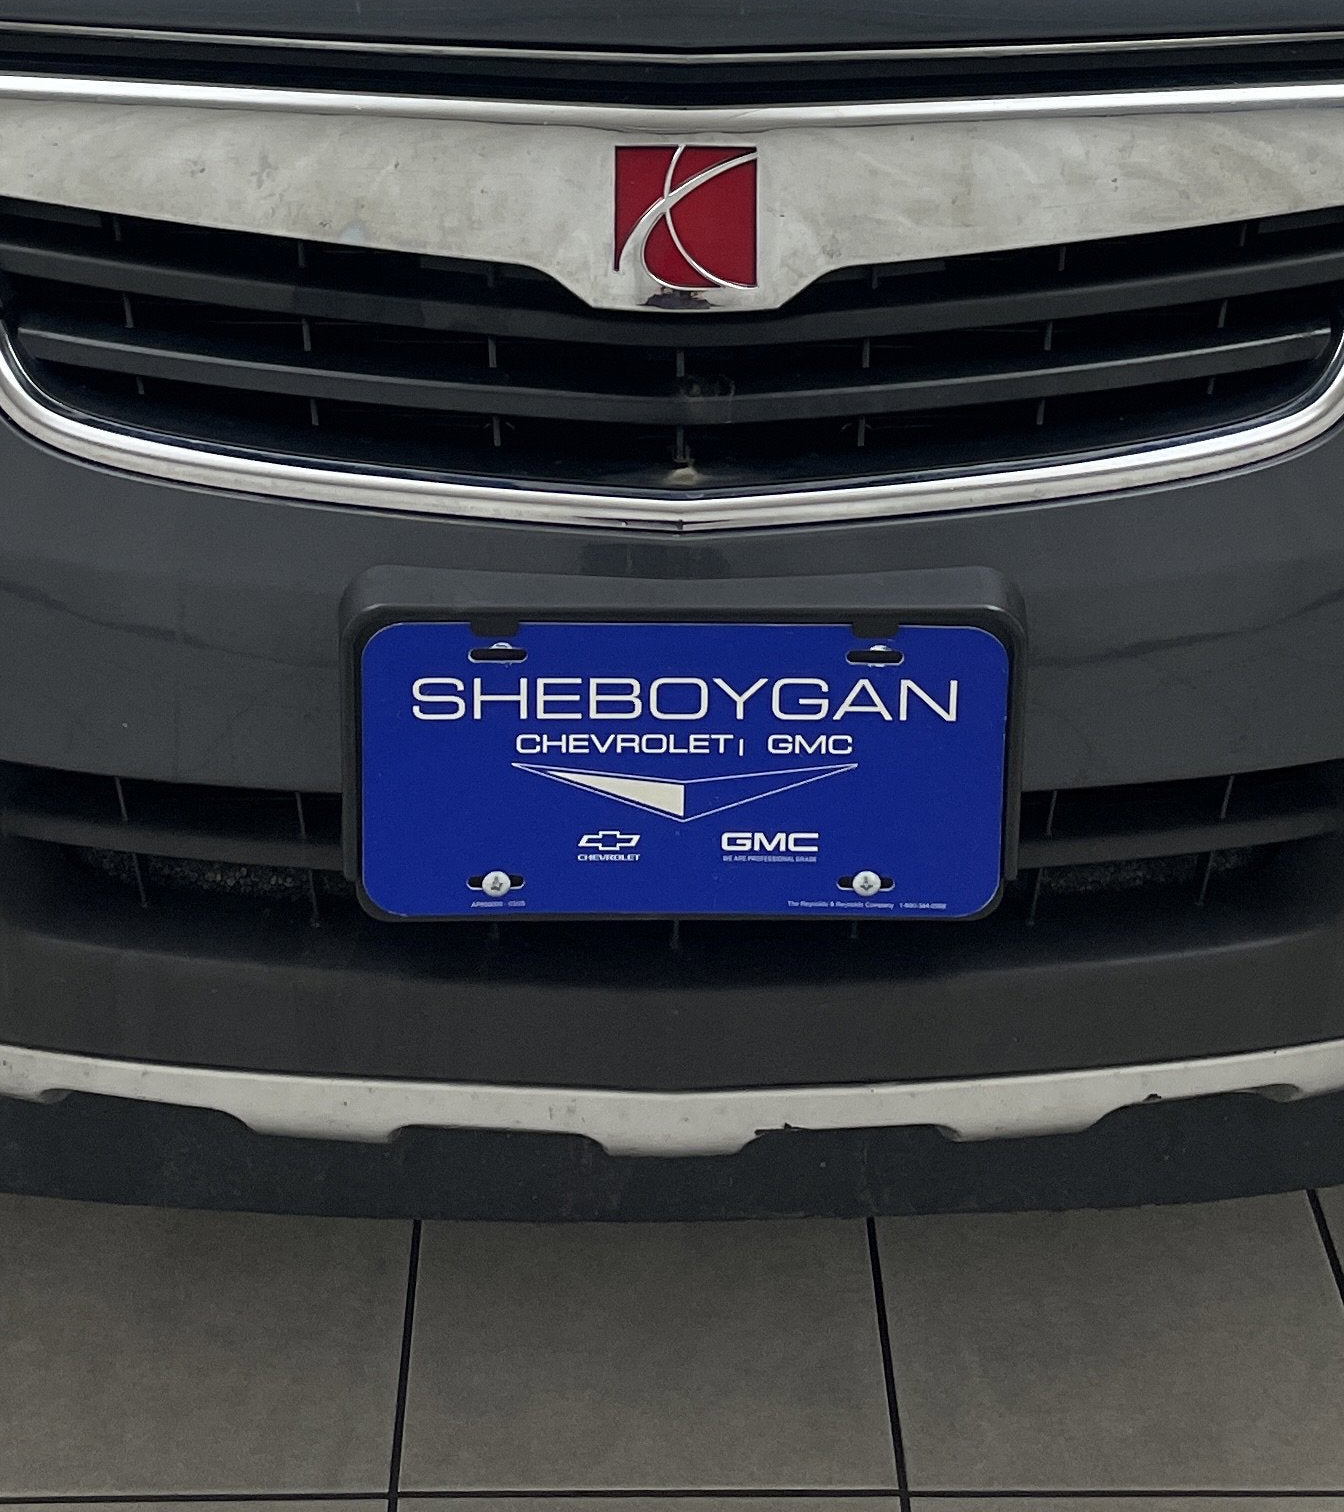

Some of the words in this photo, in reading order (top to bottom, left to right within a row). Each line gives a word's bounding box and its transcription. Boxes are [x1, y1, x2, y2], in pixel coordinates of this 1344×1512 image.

[412, 677, 958, 722] SHEBOYGAN
[767, 734, 853, 755] GMC
[721, 832, 819, 852] GMC
[577, 853, 641, 861] CHEVROLET
